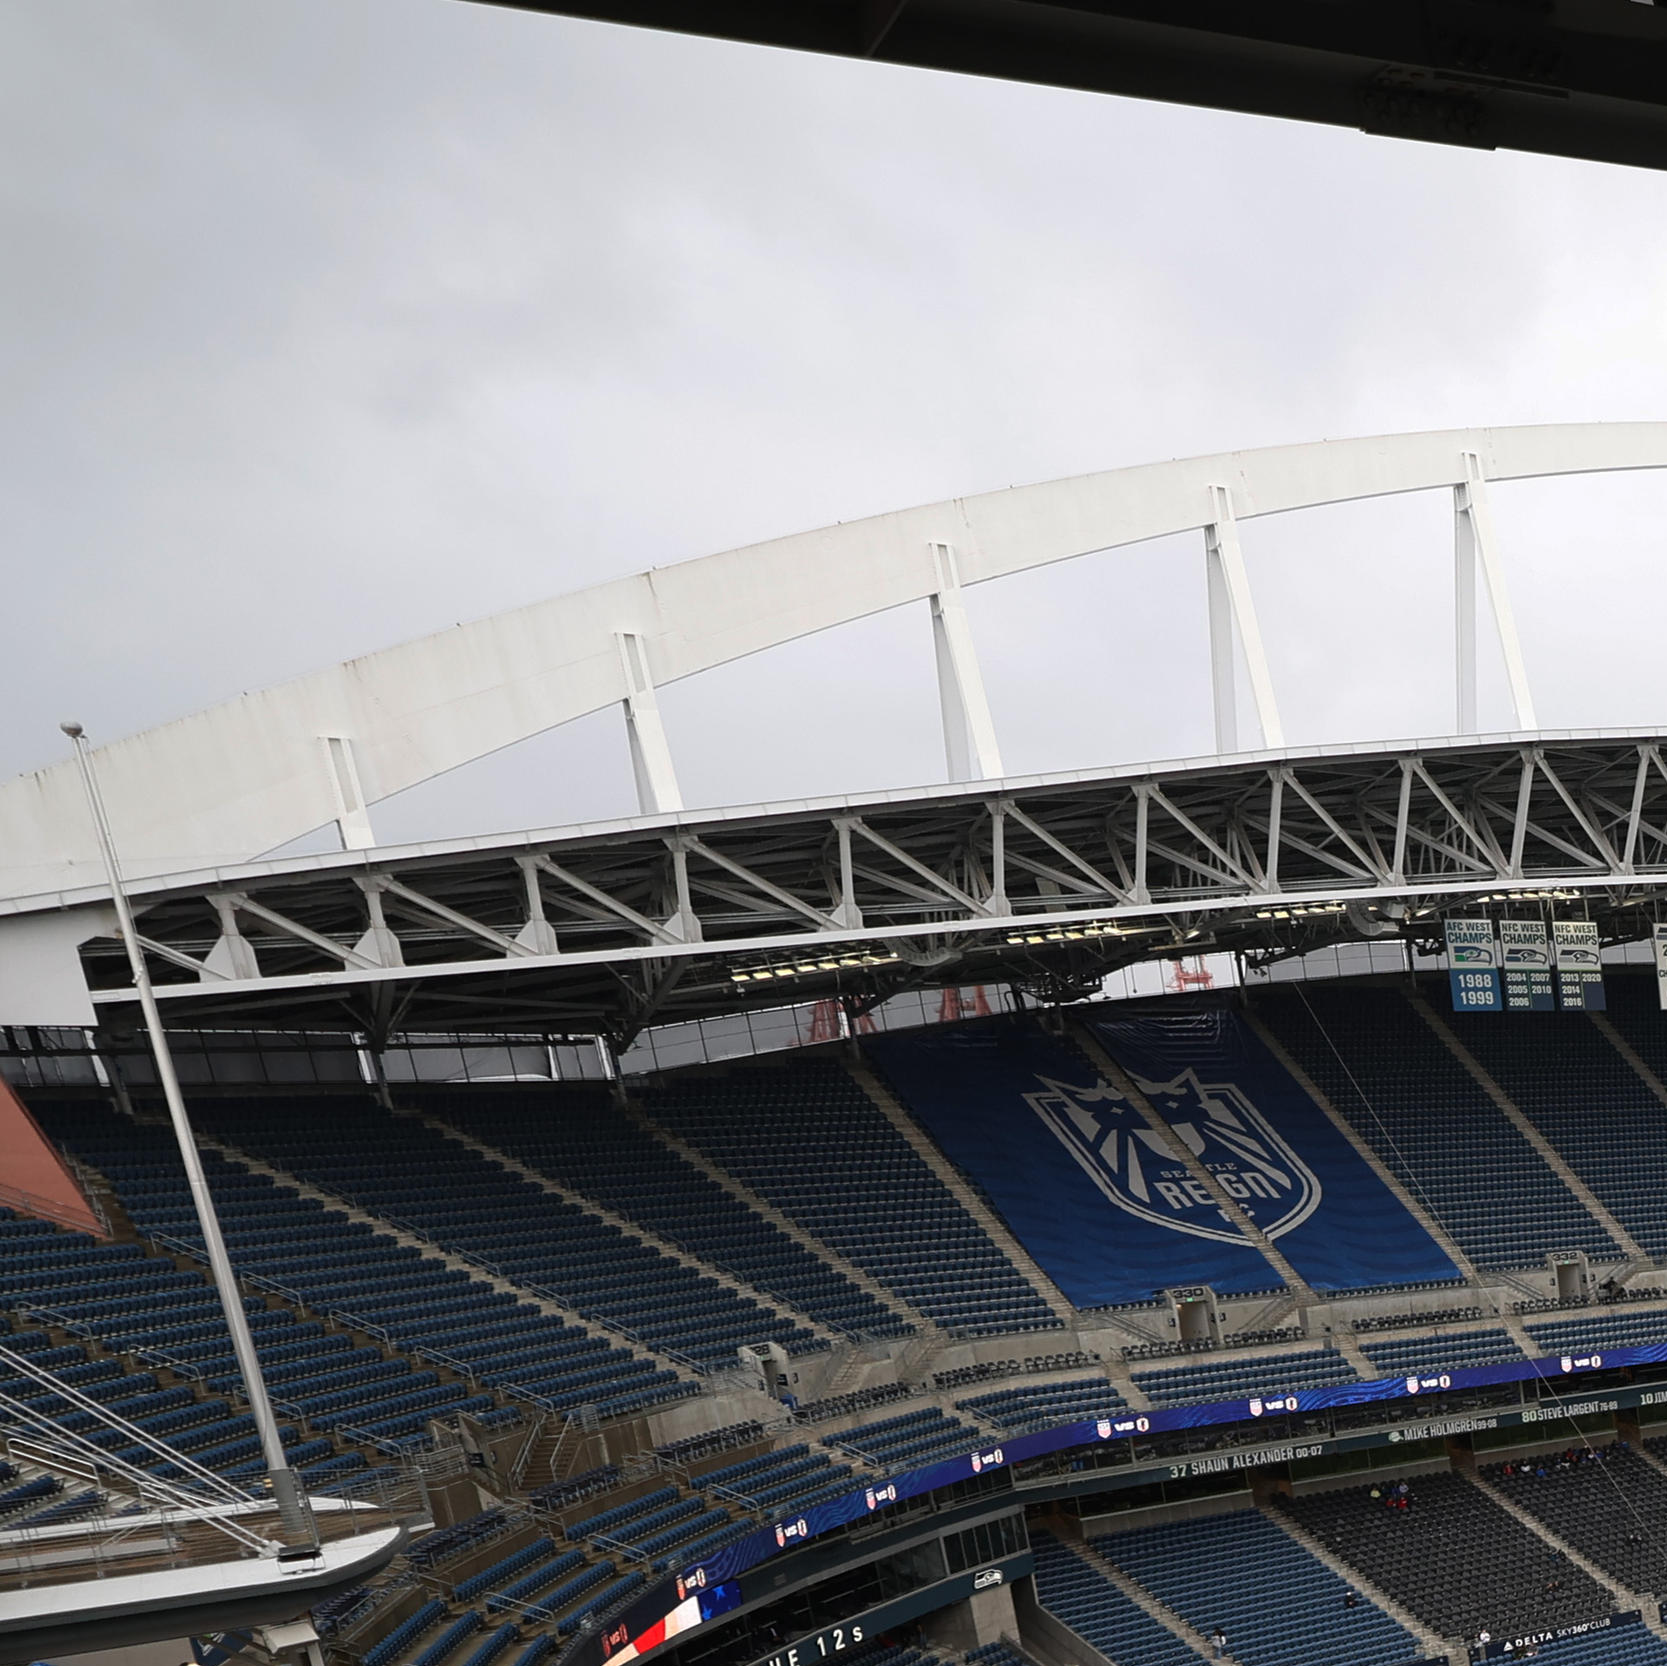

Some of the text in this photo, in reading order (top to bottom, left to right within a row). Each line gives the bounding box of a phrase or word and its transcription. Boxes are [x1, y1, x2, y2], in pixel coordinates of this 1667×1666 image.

[1447, 922, 1490, 932] AFC WEST
[1502, 924, 1545, 932] NFC WEST
[1555, 925, 1596, 933] NFC WEST
[1448, 932, 1492, 944] CHAMPS
[1503, 933, 1546, 945] CHAMPS
[1556, 934, 1597, 945] CHAMPS
[1458, 974, 1492, 988] 1988
[1560, 973, 1579, 982] 2013
[1532, 985, 1552, 994] 2010
[1460, 991, 1494, 1005] 1999
[1153, 1172, 1281, 1210] REGN
[1173, 1288, 1204, 1298] 330
[1640, 1393, 1653, 1405] 10
[1521, 1401, 1600, 1423] 80 STEVE LARGENT
[1404, 1419, 1477, 1440] MIKE HOLMGREN
[1170, 1465, 1187, 1478] 37
[1190, 1458, 1229, 1475] SHAUN
[1232, 1447, 1294, 1469] ALEXANDER
[1515, 1618, 1611, 1647] DELTA CLUB
[817, 1626, 863, 1657] 12s
